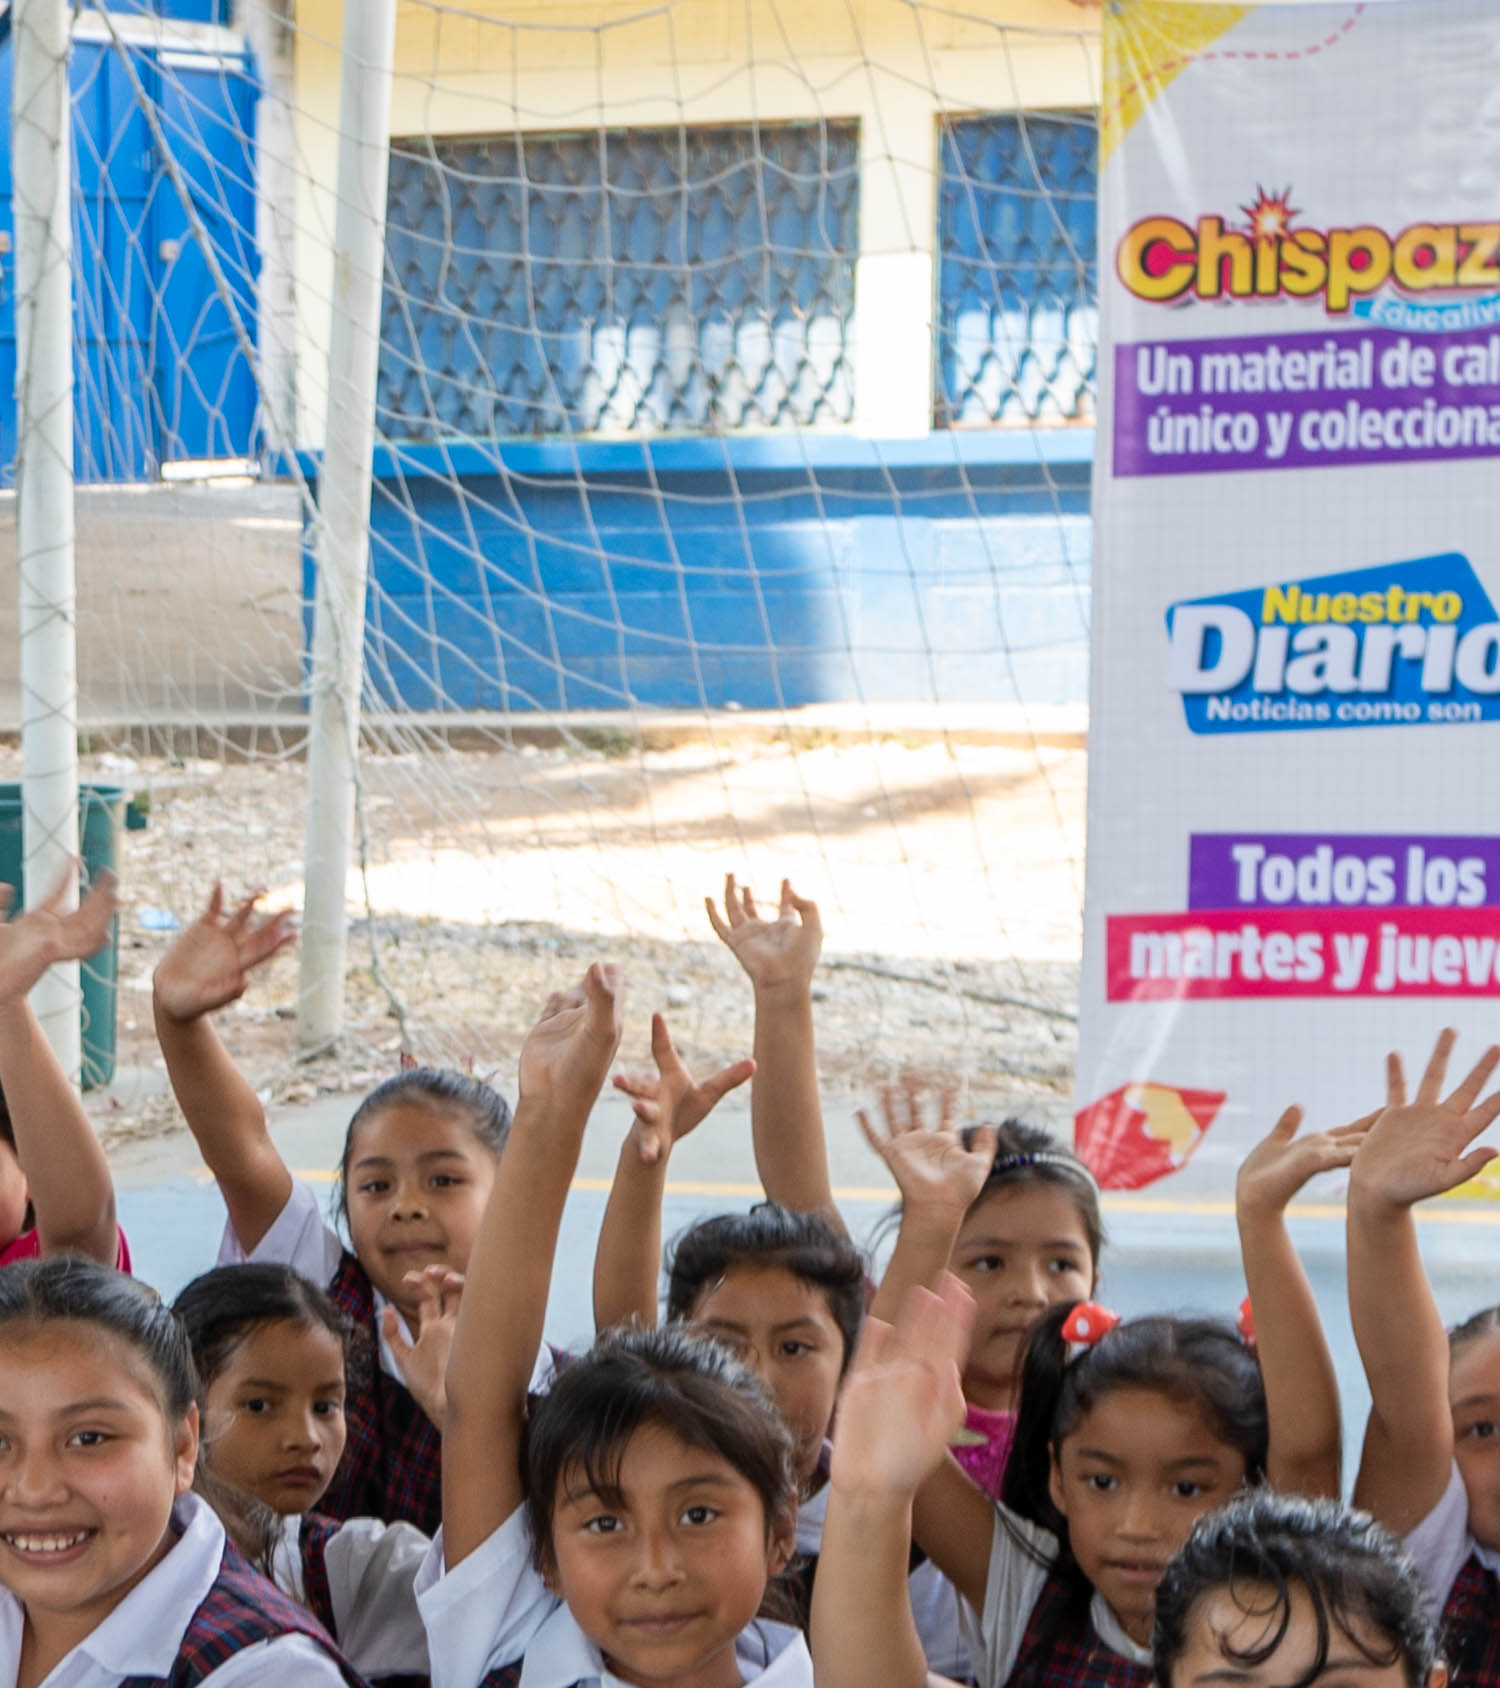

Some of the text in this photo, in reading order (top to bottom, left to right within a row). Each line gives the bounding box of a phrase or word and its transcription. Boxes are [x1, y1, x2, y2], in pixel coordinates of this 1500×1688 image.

[1136, 347, 1194, 396] Un
[1199, 338, 1375, 393] material
[1380, 336, 1436, 387] de
[1147, 405, 1261, 455] único
[1264, 408, 1294, 459] y
[1263, 585, 1461, 624] Nuestro
[1206, 696, 1483, 722] Noticias como son
[1230, 843, 1487, 907] Todos los
[1129, 922, 1326, 982] martes
[1330, 931, 1368, 990] y
